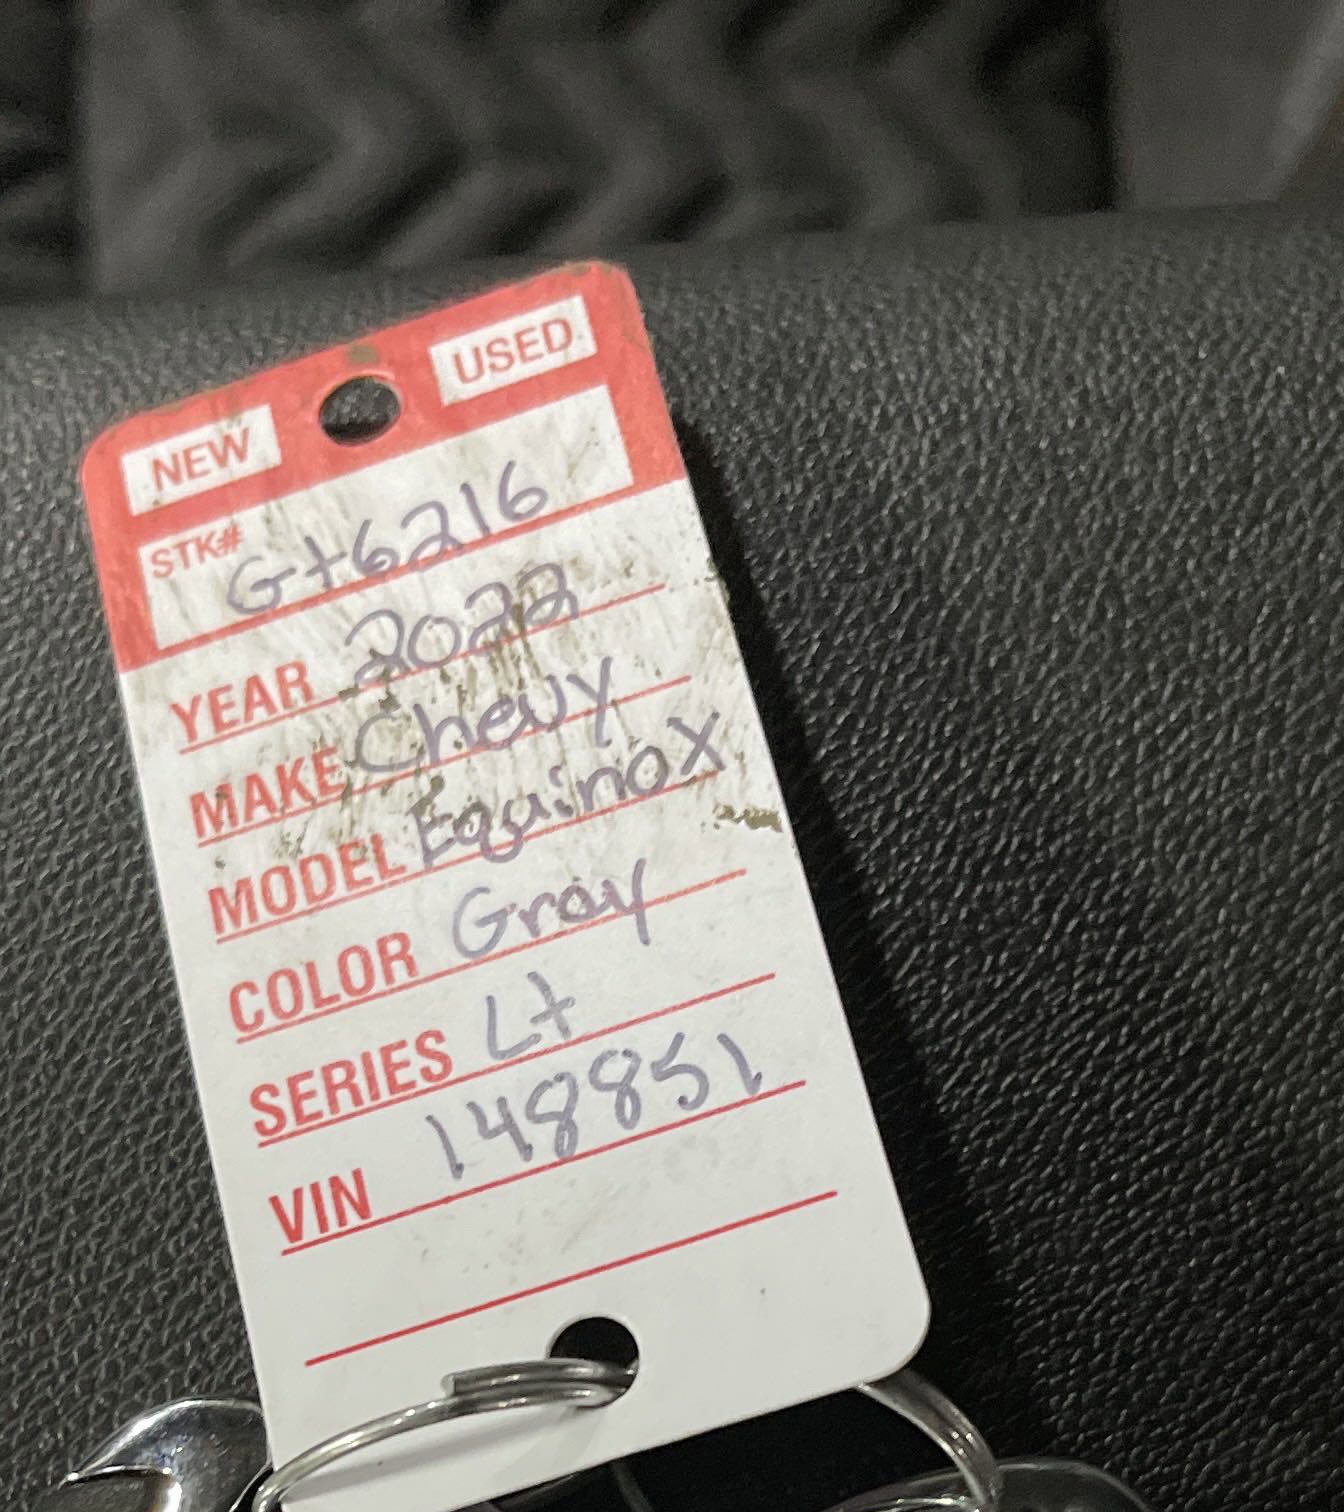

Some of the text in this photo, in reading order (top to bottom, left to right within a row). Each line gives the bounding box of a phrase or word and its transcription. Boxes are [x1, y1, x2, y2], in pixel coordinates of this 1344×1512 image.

[452, 316, 574, 385] USED
[150, 427, 252, 492] NEW
[150, 523, 244, 580] STK#
[170, 660, 316, 742] YEAR
[355, 655, 614, 775] Chevy
[188, 745, 348, 843] MAKE
[407, 711, 728, 868] Equinox
[207, 832, 408, 937] MODEL
[451, 857, 653, 961] Gray
[228, 930, 419, 1035] COLOR
[249, 1028, 455, 1141] SERIES
[426, 1030, 764, 1180] 148851
[268, 1166, 374, 1245] VIN
